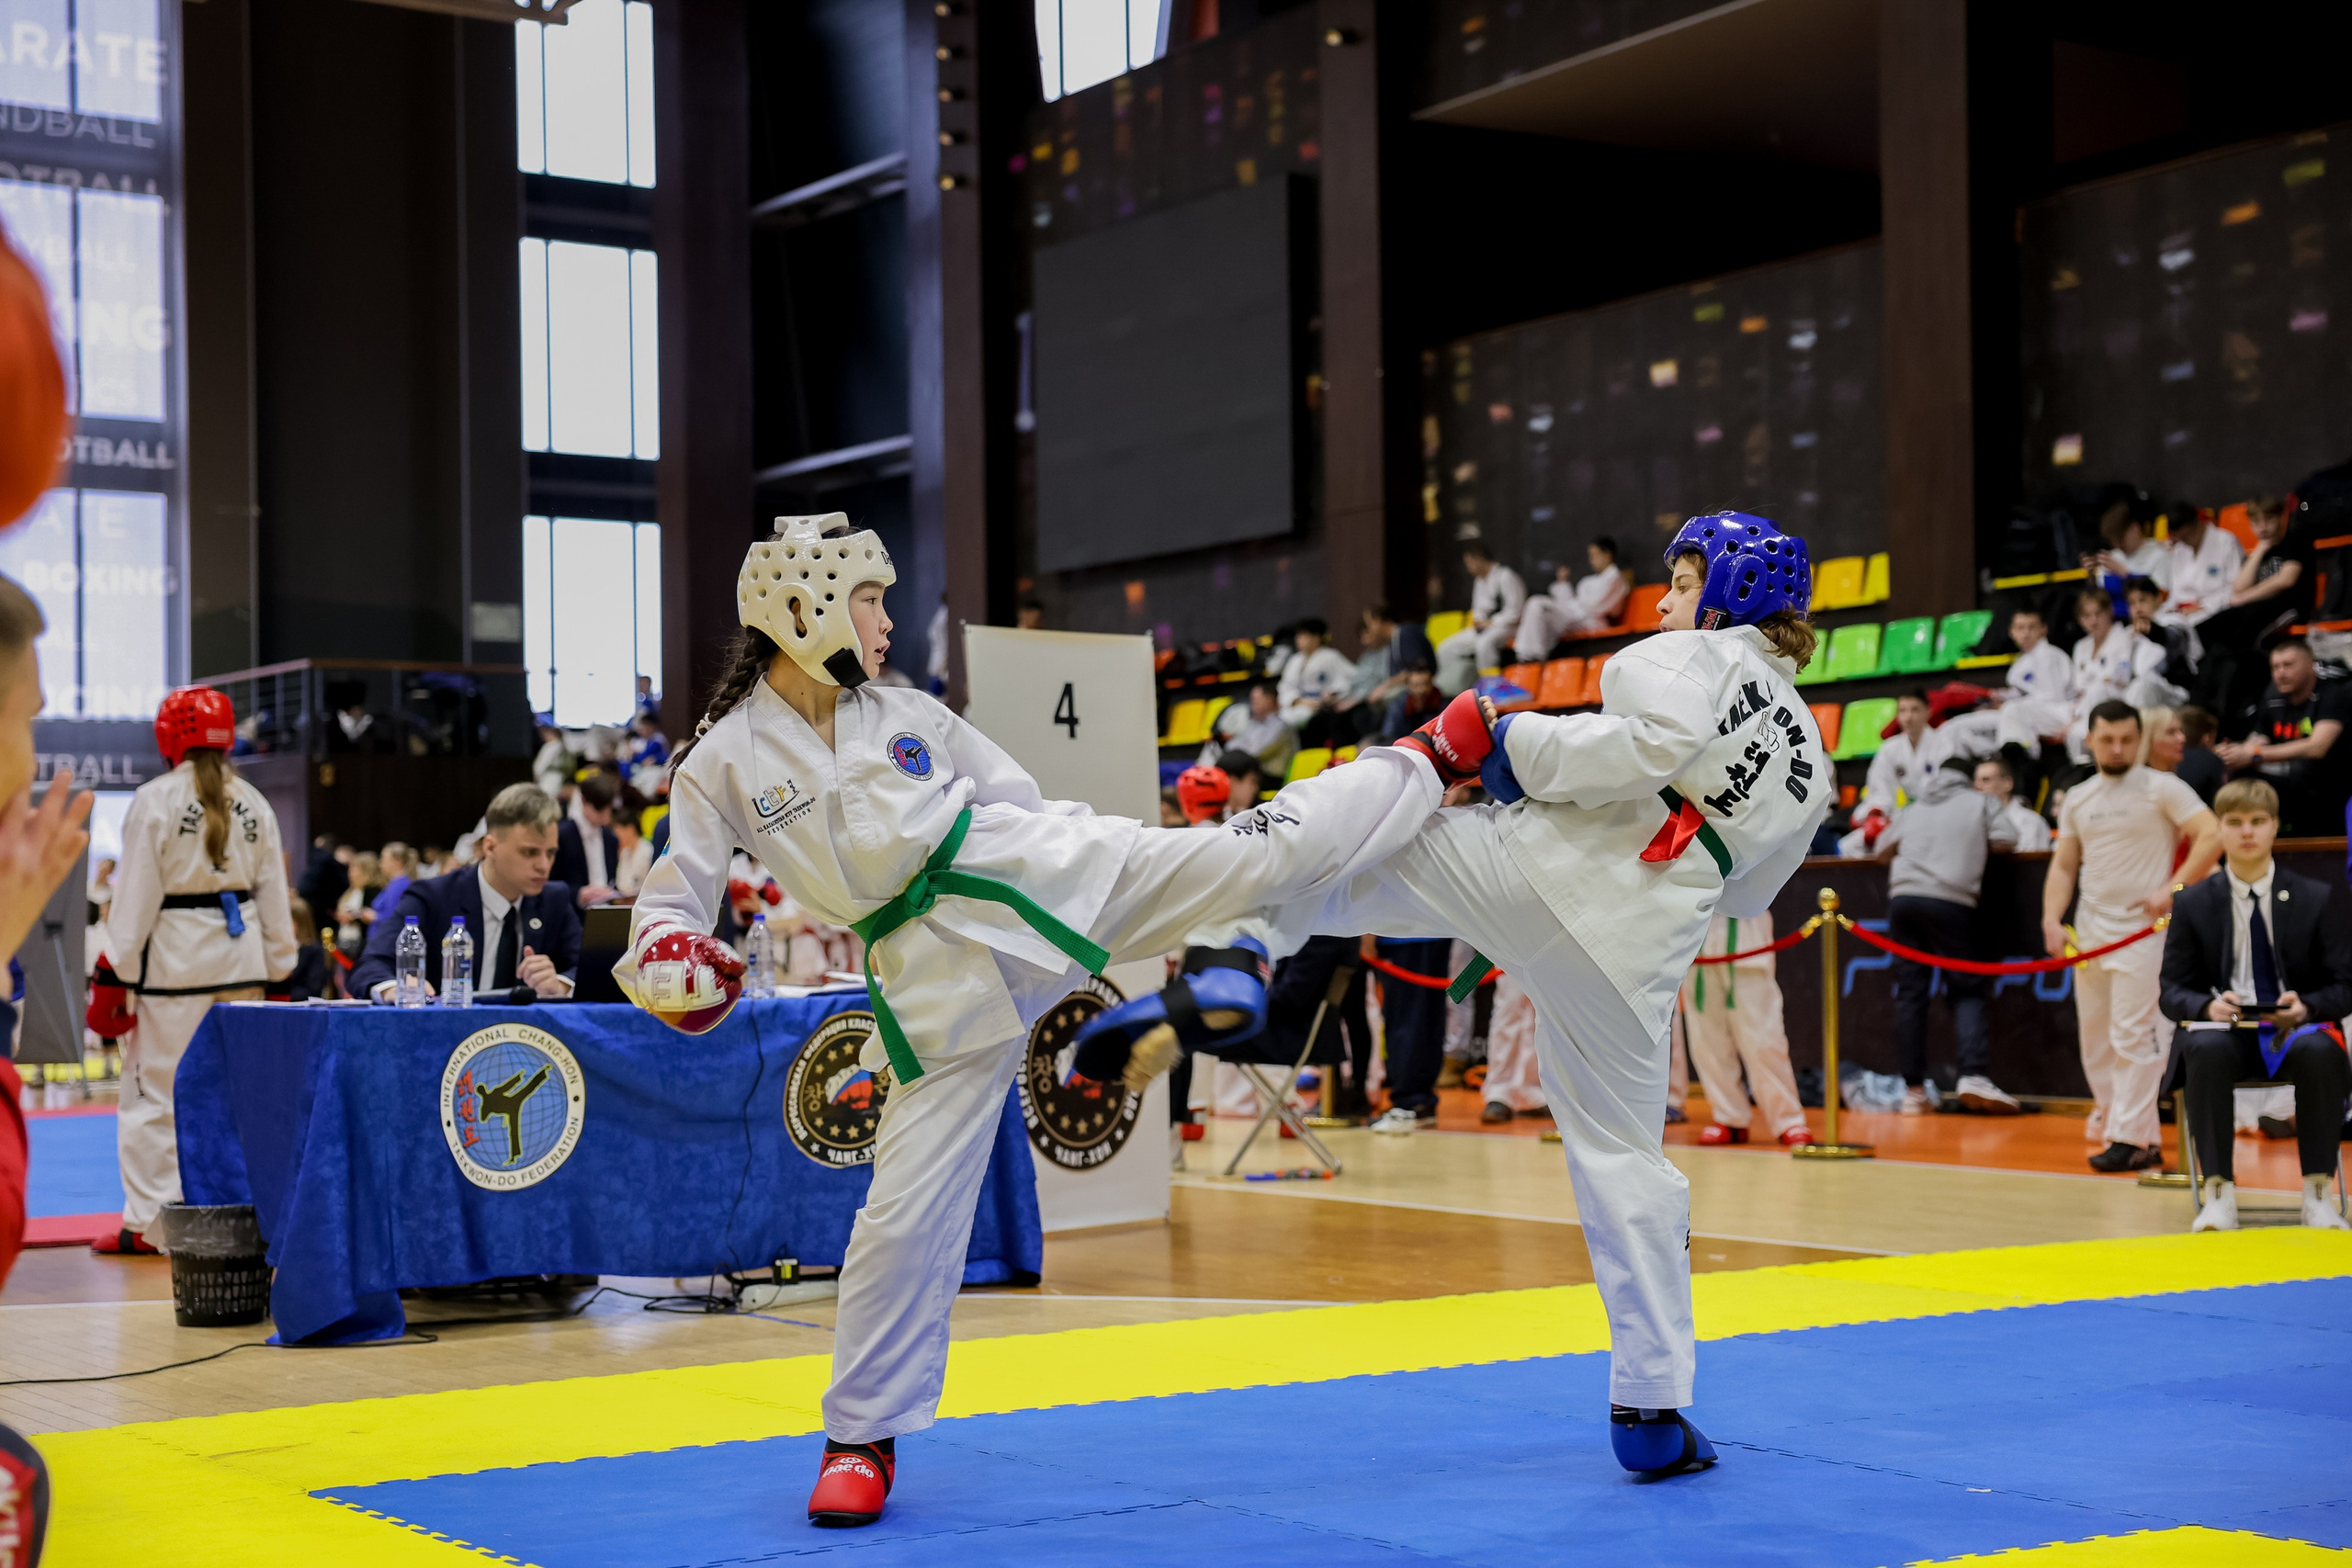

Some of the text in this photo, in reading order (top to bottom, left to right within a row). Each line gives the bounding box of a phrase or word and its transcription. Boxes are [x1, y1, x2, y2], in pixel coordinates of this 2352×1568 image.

[1053, 682, 1080, 739] 4
[1717, 679, 1814, 804] TAEKON-DO
[766, 807, 812, 836] FEDERATION
[443, 1028, 580, 1108] INTERNATIONAL CHANG-HON
[452, 1116, 580, 1186] TAEKWON-DO FEDERATION
[822, 1463, 853, 1478] pae
[854, 1464, 875, 1478] do
